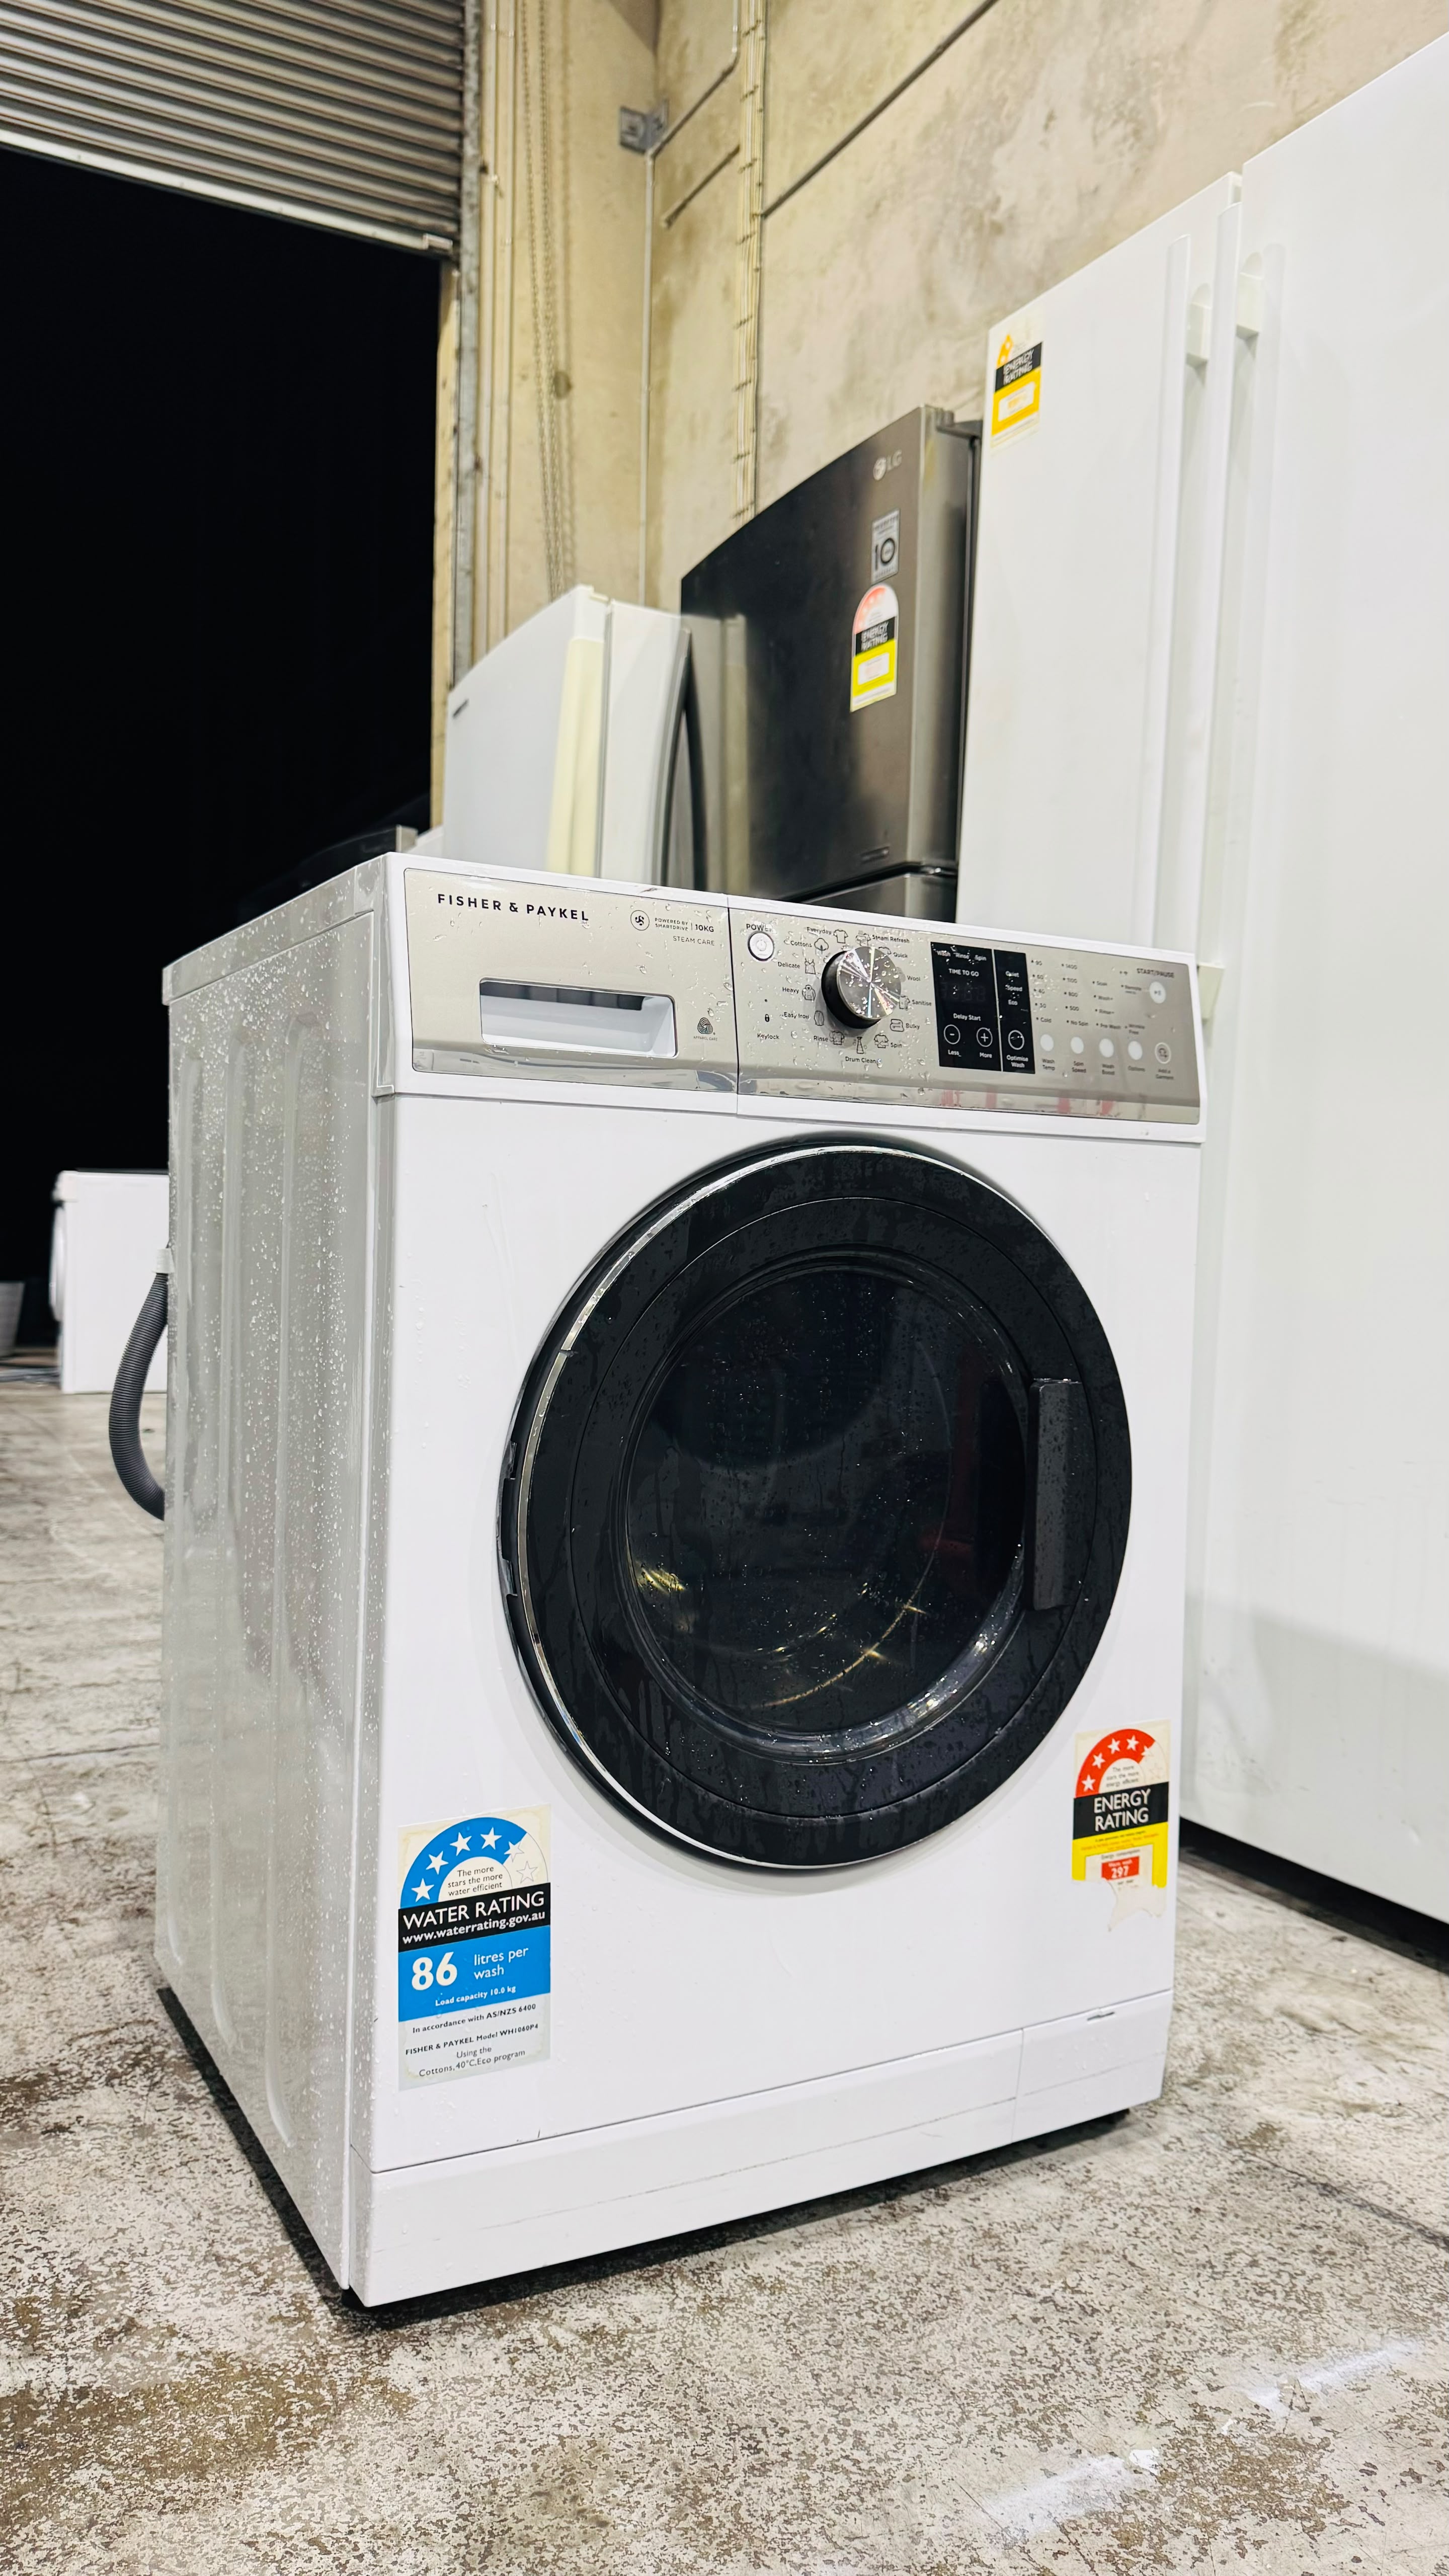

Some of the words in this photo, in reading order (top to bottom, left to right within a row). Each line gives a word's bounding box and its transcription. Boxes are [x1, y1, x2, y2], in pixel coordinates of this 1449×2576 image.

[887, 450, 902, 470] LG
[437, 894, 501, 911] FISHER
[509, 902, 518, 912] &
[527, 905, 588, 921] PAYKEL
[695, 924, 714, 932] 10KG
[807, 927, 832, 935] Everyday
[1094, 1788, 1151, 1813] ENERGY
[1095, 1807, 1149, 1831] RATING
[448, 1880, 466, 1888] stars
[483, 1874, 503, 1882] more
[474, 1866, 494, 1876] more
[1111, 1865, 1130, 1879] 297
[448, 1888, 470, 1896] water
[472, 1882, 503, 1892] efficient
[403, 1905, 469, 1930] WATER
[475, 1891, 544, 1918] RATING
[403, 1911, 545, 1944] www.waterrating.gov.au
[411, 1952, 457, 1991] 86
[474, 1952, 504, 1966] litres
[508, 1947, 529, 1963] per
[473, 1964, 504, 1980] wash
[435, 1997, 454, 2006] Load
[456, 1991, 488, 2003] capacity
[490, 1988, 505, 1996] 10.0
[422, 2018, 466, 2032] accordance
[468, 2014, 484, 2022] with
[486, 2007, 516, 2020] AS/NZS
[519, 2003, 536, 2013] 6400
[406, 2044, 434, 2055] FISHER
[443, 2037, 474, 2048] PAYKEL
[476, 2032, 498, 2041] Model
[500, 2023, 538, 2037] WH1060P4
[419, 2065, 455, 2077] Cottons,
[494, 2050, 525, 2063] program
[456, 2048, 477, 2059] Using
